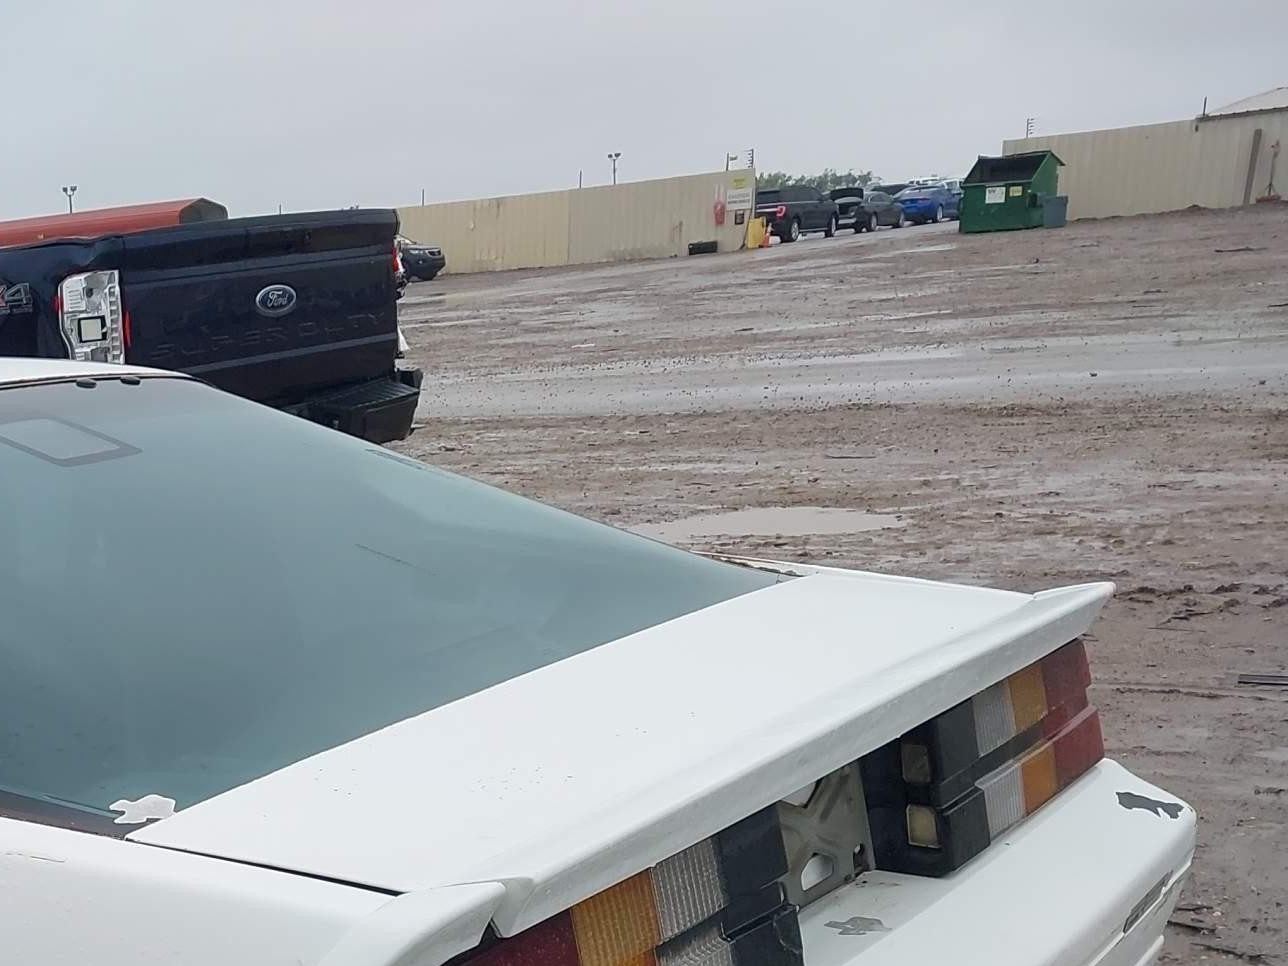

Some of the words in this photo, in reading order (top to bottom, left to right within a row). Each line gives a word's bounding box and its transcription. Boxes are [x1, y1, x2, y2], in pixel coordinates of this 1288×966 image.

[267, 291, 289, 307] Ford
[151, 327, 289, 361] SUPER
[298, 312, 385, 336] DUTY
